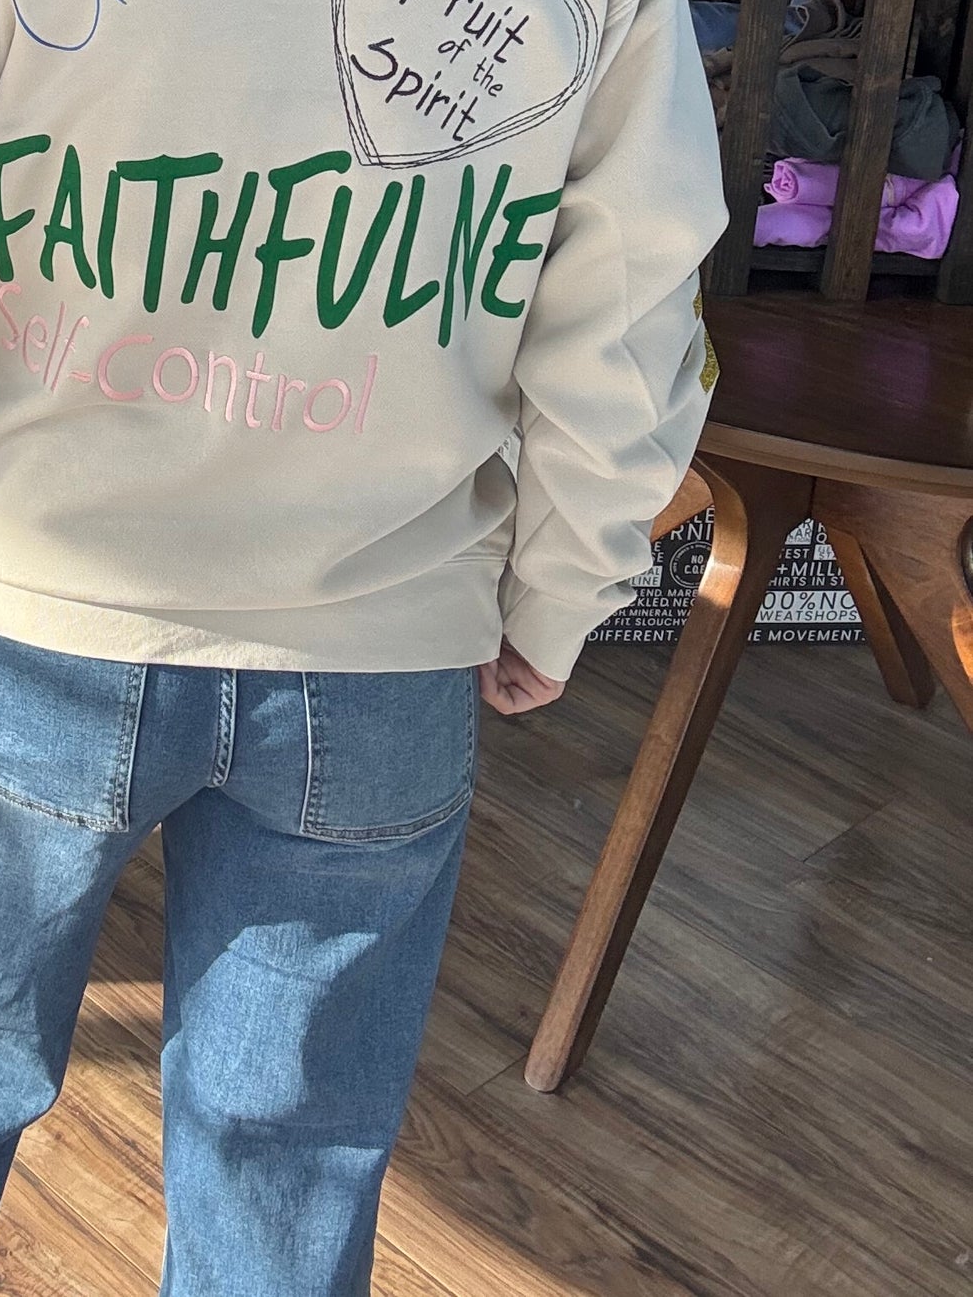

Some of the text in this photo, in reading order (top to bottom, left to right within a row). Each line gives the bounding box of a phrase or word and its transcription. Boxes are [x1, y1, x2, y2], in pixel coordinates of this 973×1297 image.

[438, 38, 504, 97] of the
[350, 37, 479, 142] Spirit
[778, 548, 810, 559] EST
[811, 577, 826, 586] IN
[630, 598, 669, 607] KLED.
[628, 608, 673, 617] MINERAL
[767, 629, 866, 642] MOVEMENT.
